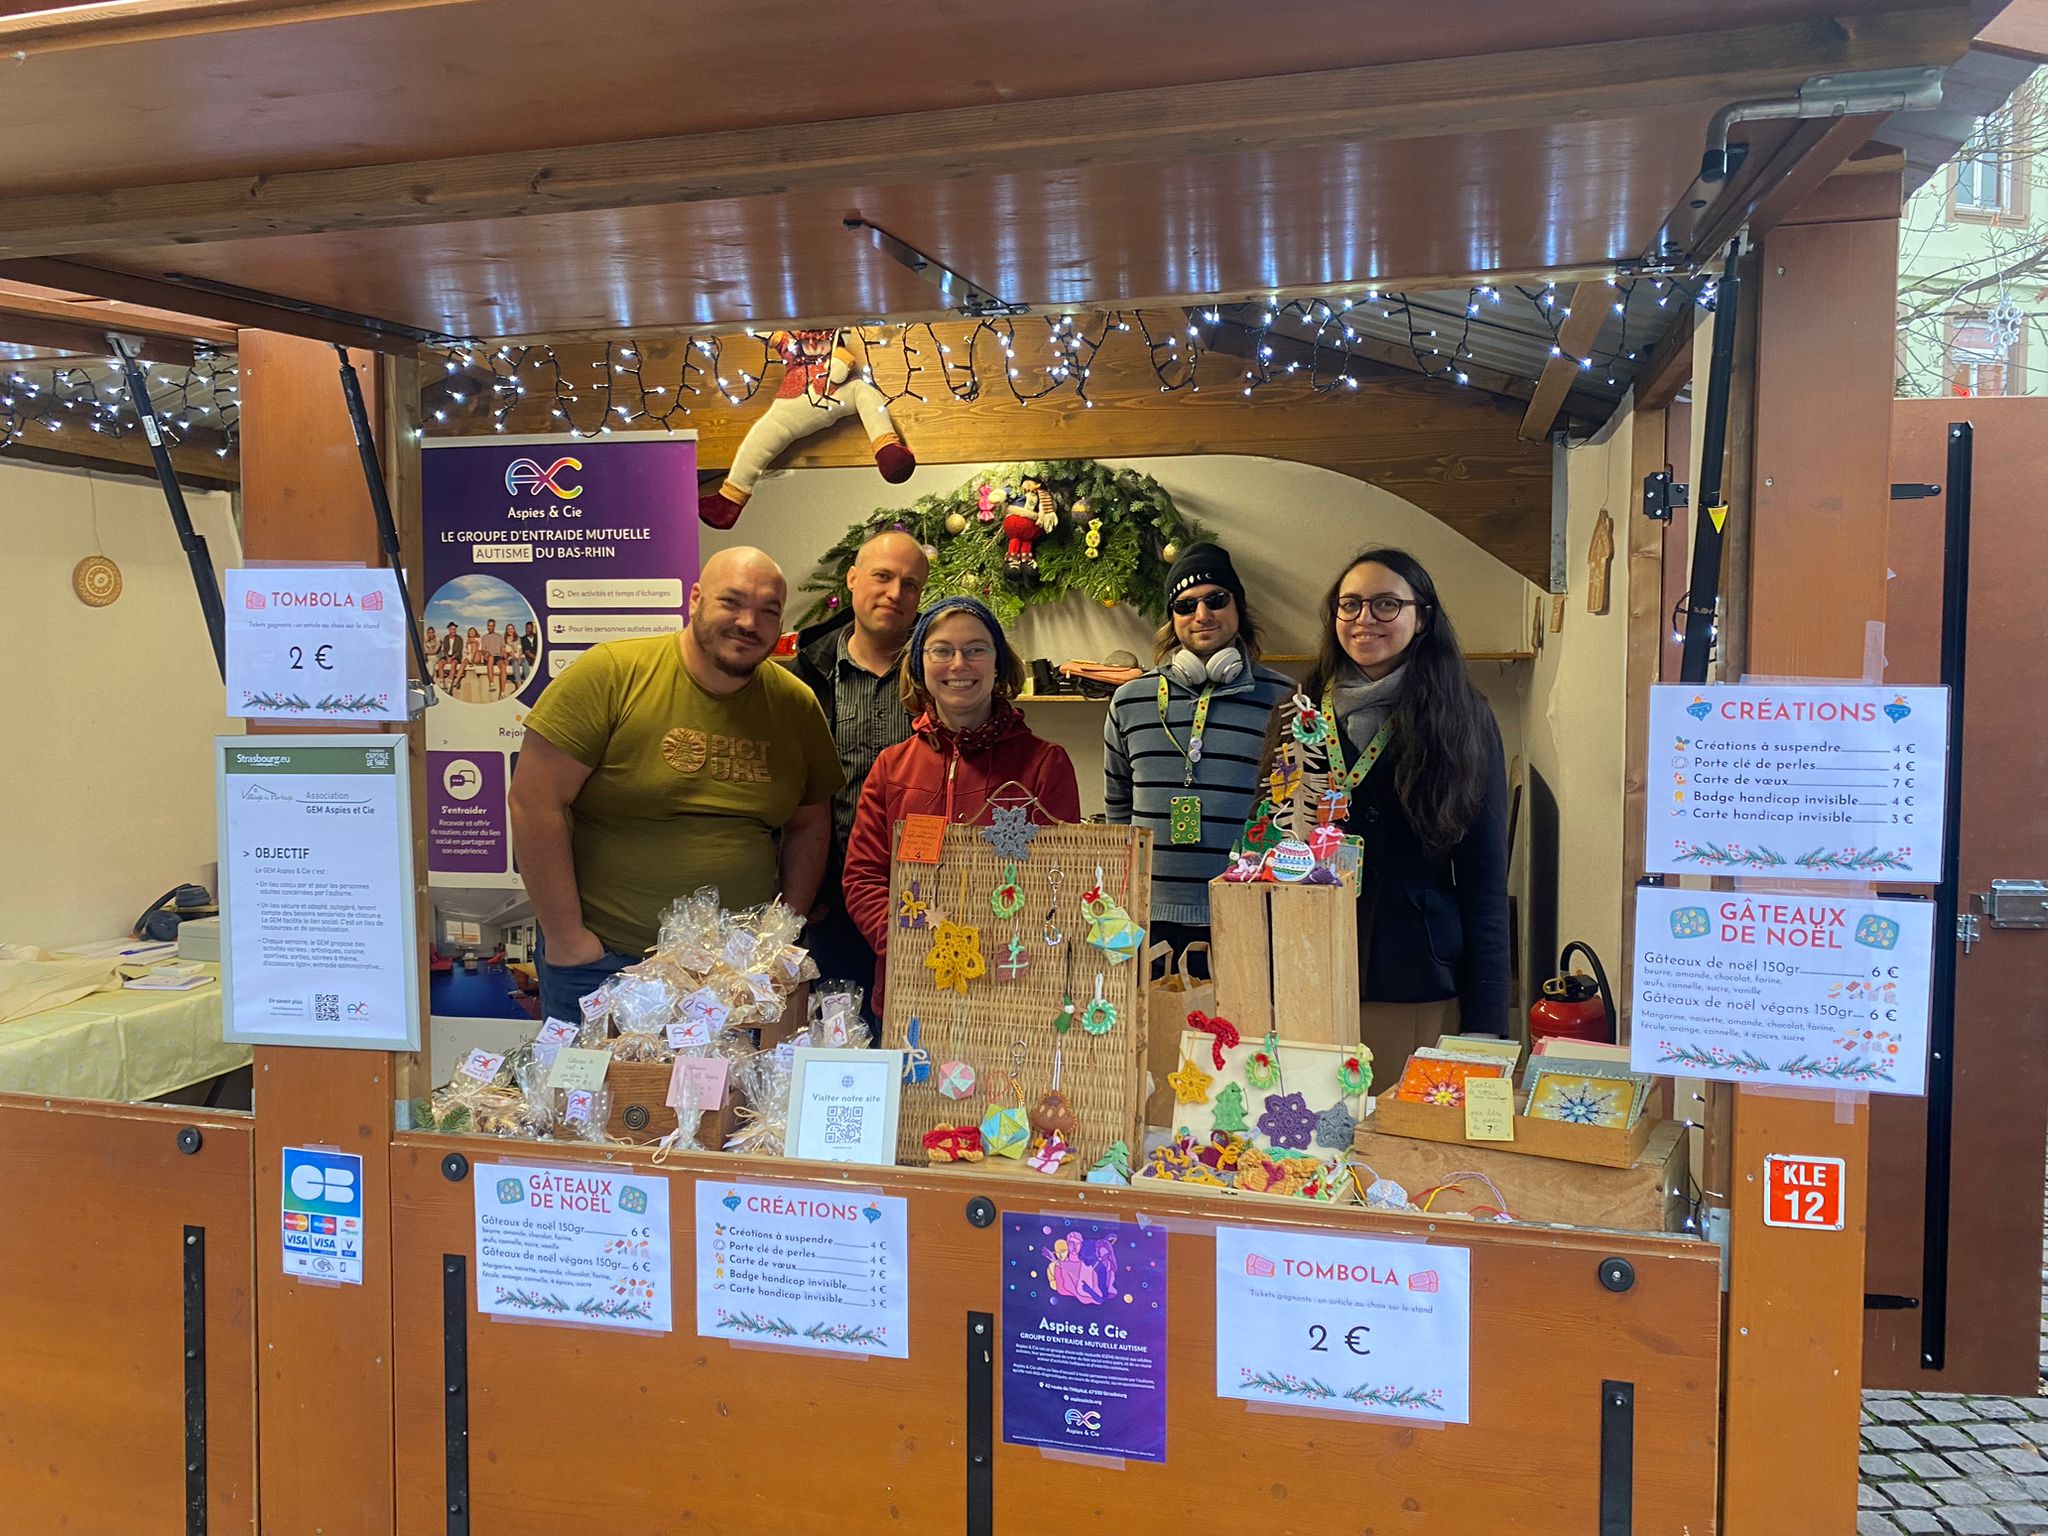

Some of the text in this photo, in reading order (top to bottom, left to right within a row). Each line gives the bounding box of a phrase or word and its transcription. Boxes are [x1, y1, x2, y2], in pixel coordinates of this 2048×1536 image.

[508, 506, 582, 520] Aspies & Cie
[441, 528, 650, 542] LE GROUPE D'ENTRAIDE MUTUELLE
[476, 547, 615, 559] AUTISME DU BAS-RHIN
[272, 592, 354, 607] TOMBOLA
[636, 590, 670, 598] d'échanges
[290, 645, 333, 670] 2 €
[1720, 697, 1876, 722] CRÉATIONS
[1695, 740, 1916, 754] Créations à suspendre 4 €
[237, 754, 290, 764] Strasbourg.eu
[1694, 759, 1915, 772] Porte clé de perles 4 €
[1694, 774, 1914, 788] Carte de vœux 7 €
[441, 806, 487, 814] S'entraider
[1694, 792, 1914, 806] Badge handicap invisible 4 €
[306, 806, 323, 814] GEM
[325, 806, 350, 815] Aspies
[1694, 808, 1914, 824] Carte handicap invisible 3 €
[256, 848, 309, 859] OBJECTIF
[1720, 898, 1846, 927] GÂTEAUX
[1721, 924, 1842, 949] DE NOËL
[1644, 951, 1899, 979] Gâteaux de noël 150gr 6 €
[1644, 967, 1783, 985] beurre, amande, chocolat, farine,
[1642, 991, 1897, 1022] Gâteaux de noël végans 150gr 6 €
[813, 1094, 839, 1102] Visiter
[842, 1094, 863, 1102] notre
[291, 1165, 354, 1203] CB
[529, 1171, 612, 1196] GÂTEAUX
[1784, 1164, 1826, 1187] KLE
[530, 1193, 611, 1213] DE NOËL
[747, 1195, 857, 1221] CRÉATIONS
[1784, 1191, 1824, 1222] 12
[482, 1214, 650, 1238] Gâteaux de noël 150gr 6 €
[287, 1234, 308, 1246] VISA
[314, 1238, 335, 1248] VISA
[729, 1227, 772, 1240] Créations
[776, 1232, 781, 1240] à
[785, 1234, 833, 1244] suspendre
[880, 1242, 886, 1250] €
[730, 1242, 754, 1251] Porte
[757, 1244, 769, 1253] clé
[773, 1246, 784, 1255] de
[788, 1248, 815, 1258] perles
[880, 1256, 886, 1265] €
[729, 1255, 754, 1265] Carte
[758, 1257, 769, 1266] de
[772, 1261, 796, 1270] vœux
[879, 1271, 886, 1279] €
[1283, 1258, 1399, 1286] TOMBOLA
[730, 1269, 759, 1281] Badge
[762, 1274, 805, 1286] handicap
[809, 1278, 847, 1290] invisible
[880, 1285, 886, 1294] €
[730, 1284, 886, 1309] Carte handicap invisible 3 €
[1250, 1289, 1275, 1299] Tickets
[1277, 1293, 1312, 1303] gagnants
[1327, 1297, 1352, 1307] article
[1367, 1301, 1386, 1309] choix
[1410, 1305, 1433, 1314] stand
[1039, 1317, 1128, 1339] Aspies & Cie
[1020, 1332, 1147, 1352] GROUPE D'ENTRAIDE MUTUELLE AUTISME
[1308, 1324, 1370, 1355] 2 €
